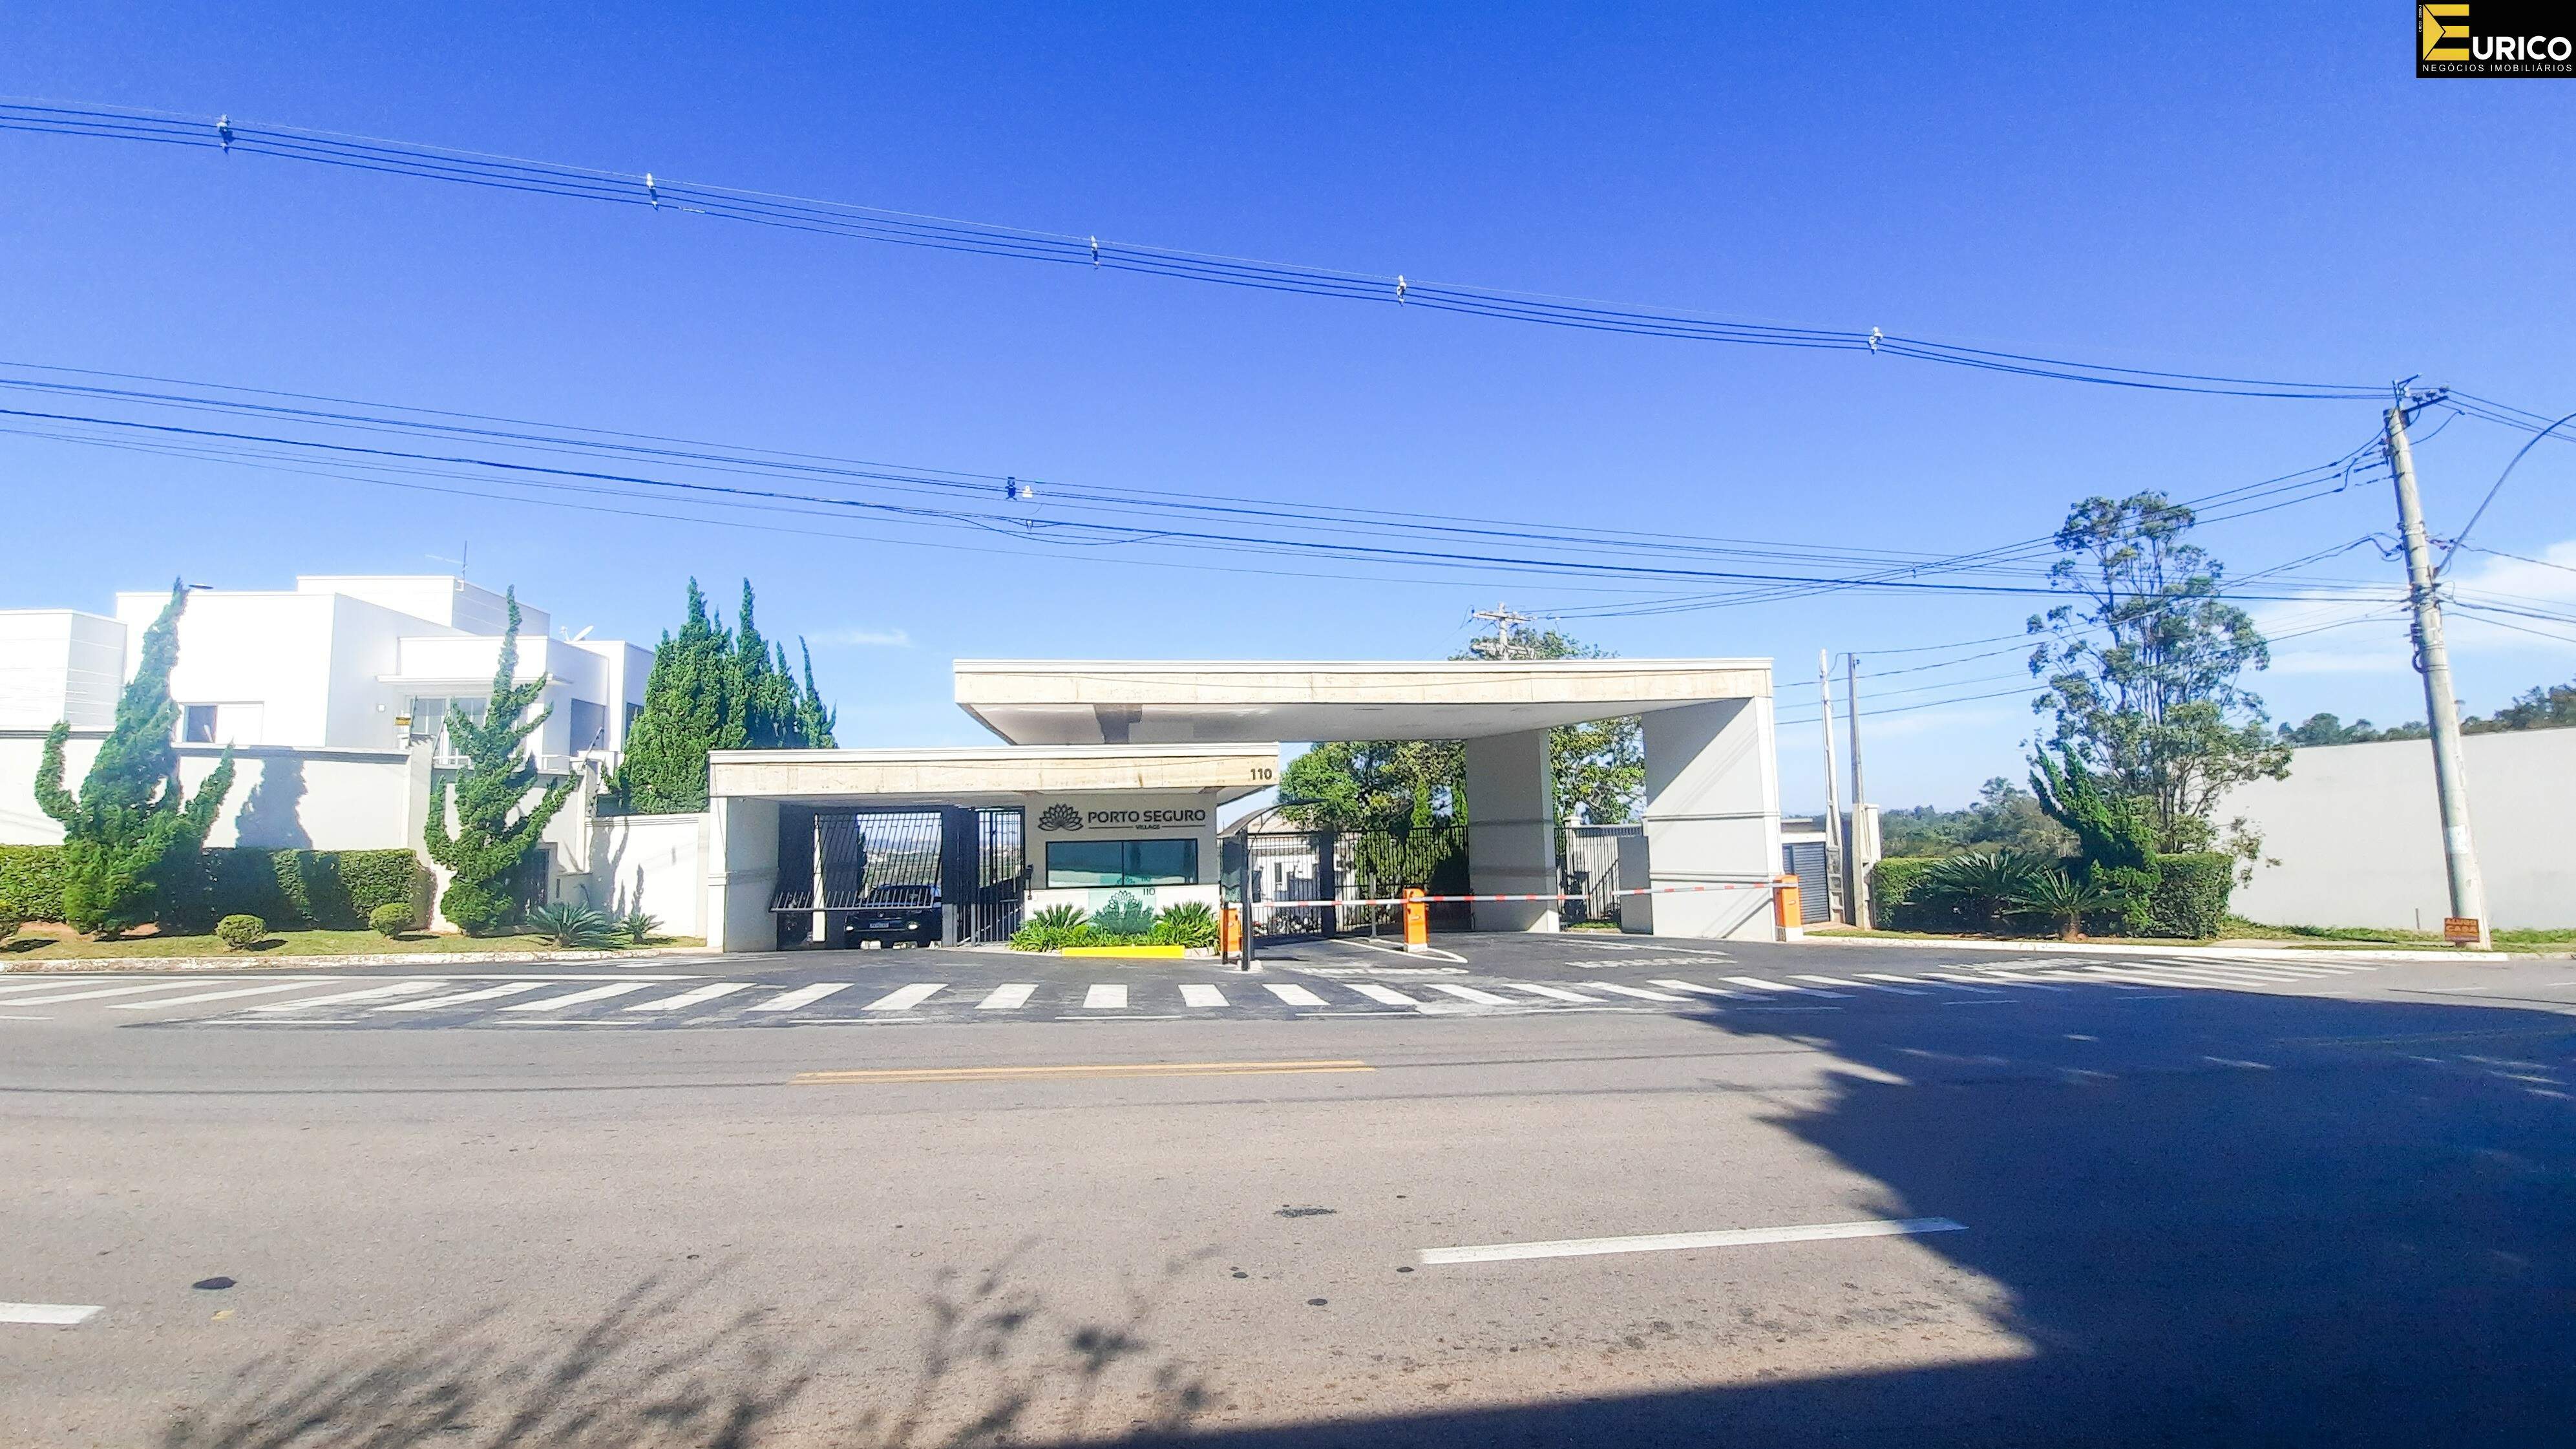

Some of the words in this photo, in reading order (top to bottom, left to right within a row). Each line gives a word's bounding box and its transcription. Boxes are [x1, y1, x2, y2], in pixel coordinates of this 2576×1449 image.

[1251, 768, 1272, 780] 110
[1088, 811, 1139, 823] PORTO
[1143, 810, 1206, 821] SEGURO
